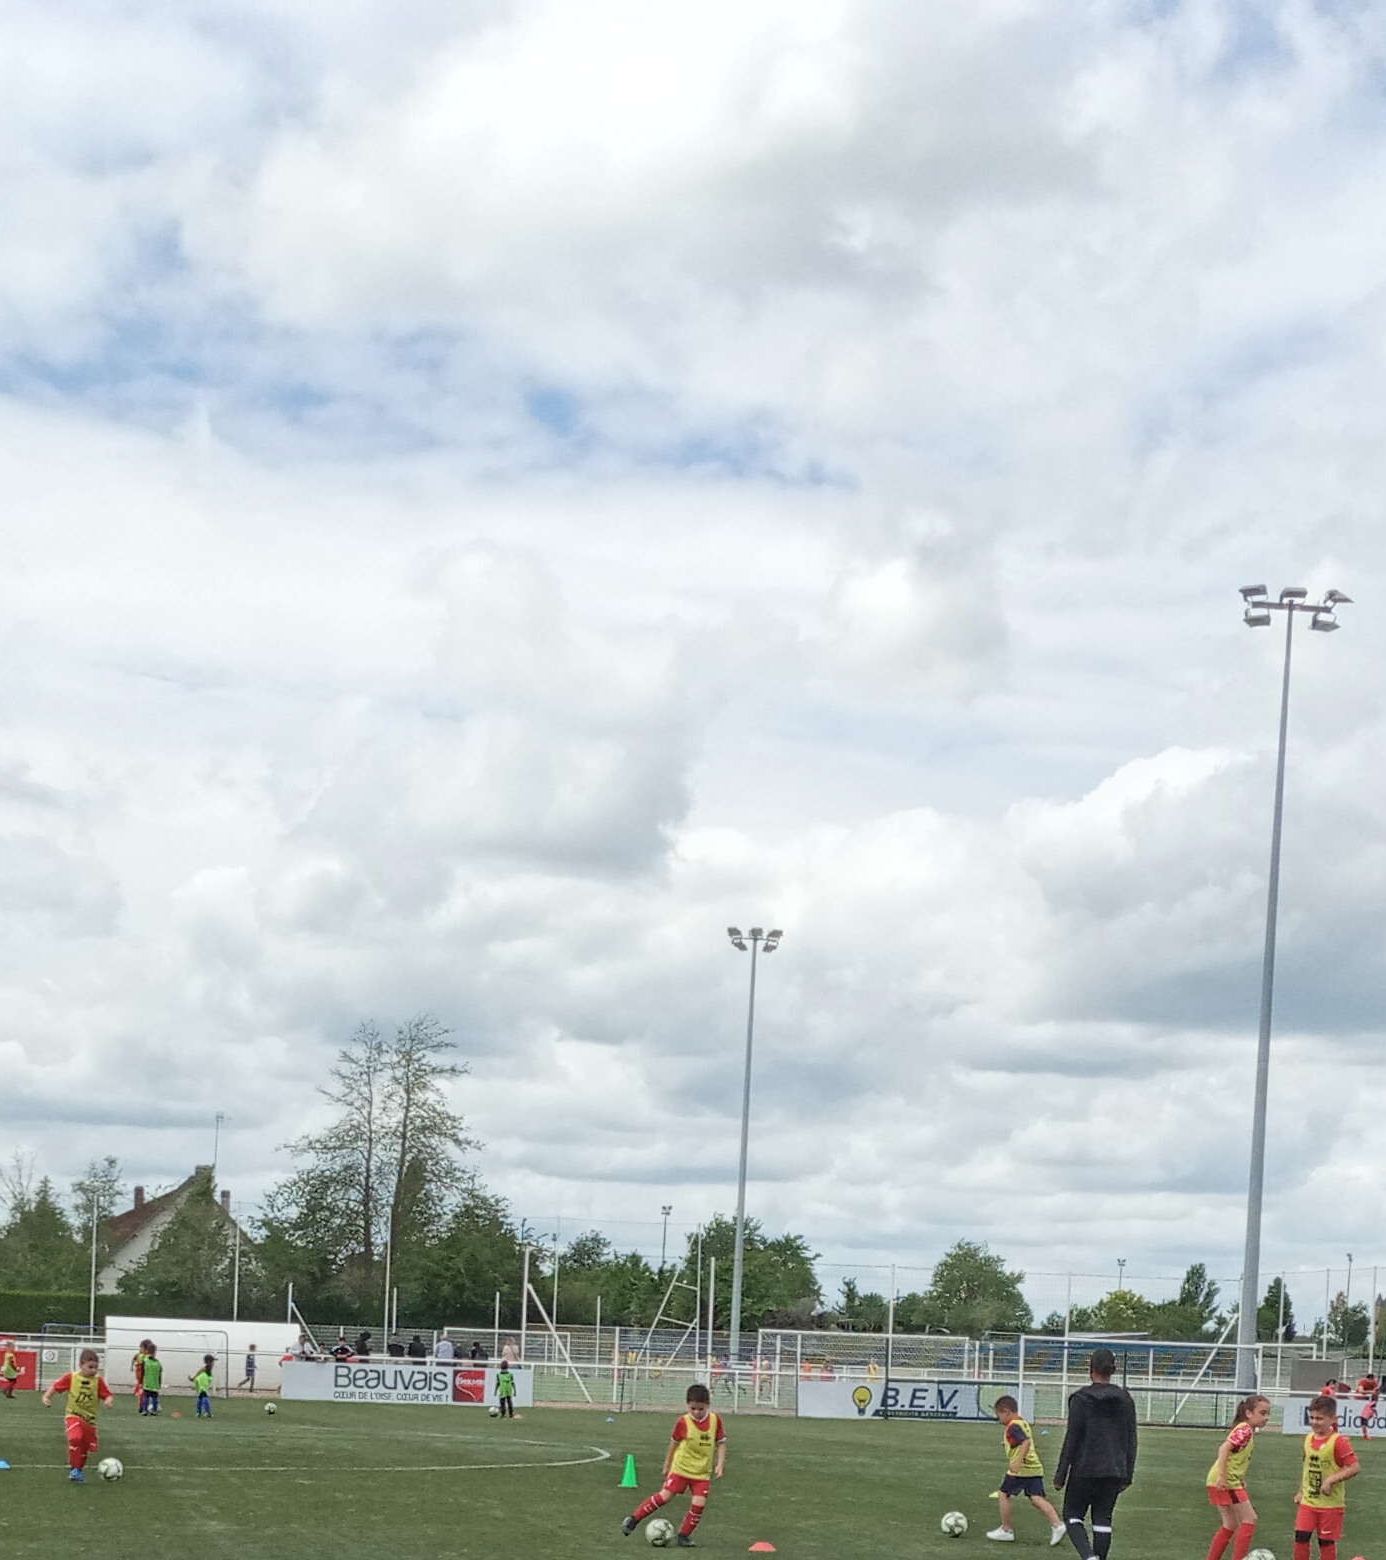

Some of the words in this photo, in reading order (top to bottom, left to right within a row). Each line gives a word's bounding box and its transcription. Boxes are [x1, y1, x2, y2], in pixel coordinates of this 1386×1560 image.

[334, 1365, 448, 1391] Beauvais
[358, 1391, 368, 1399] DE
[420, 1394, 430, 1402] DE
